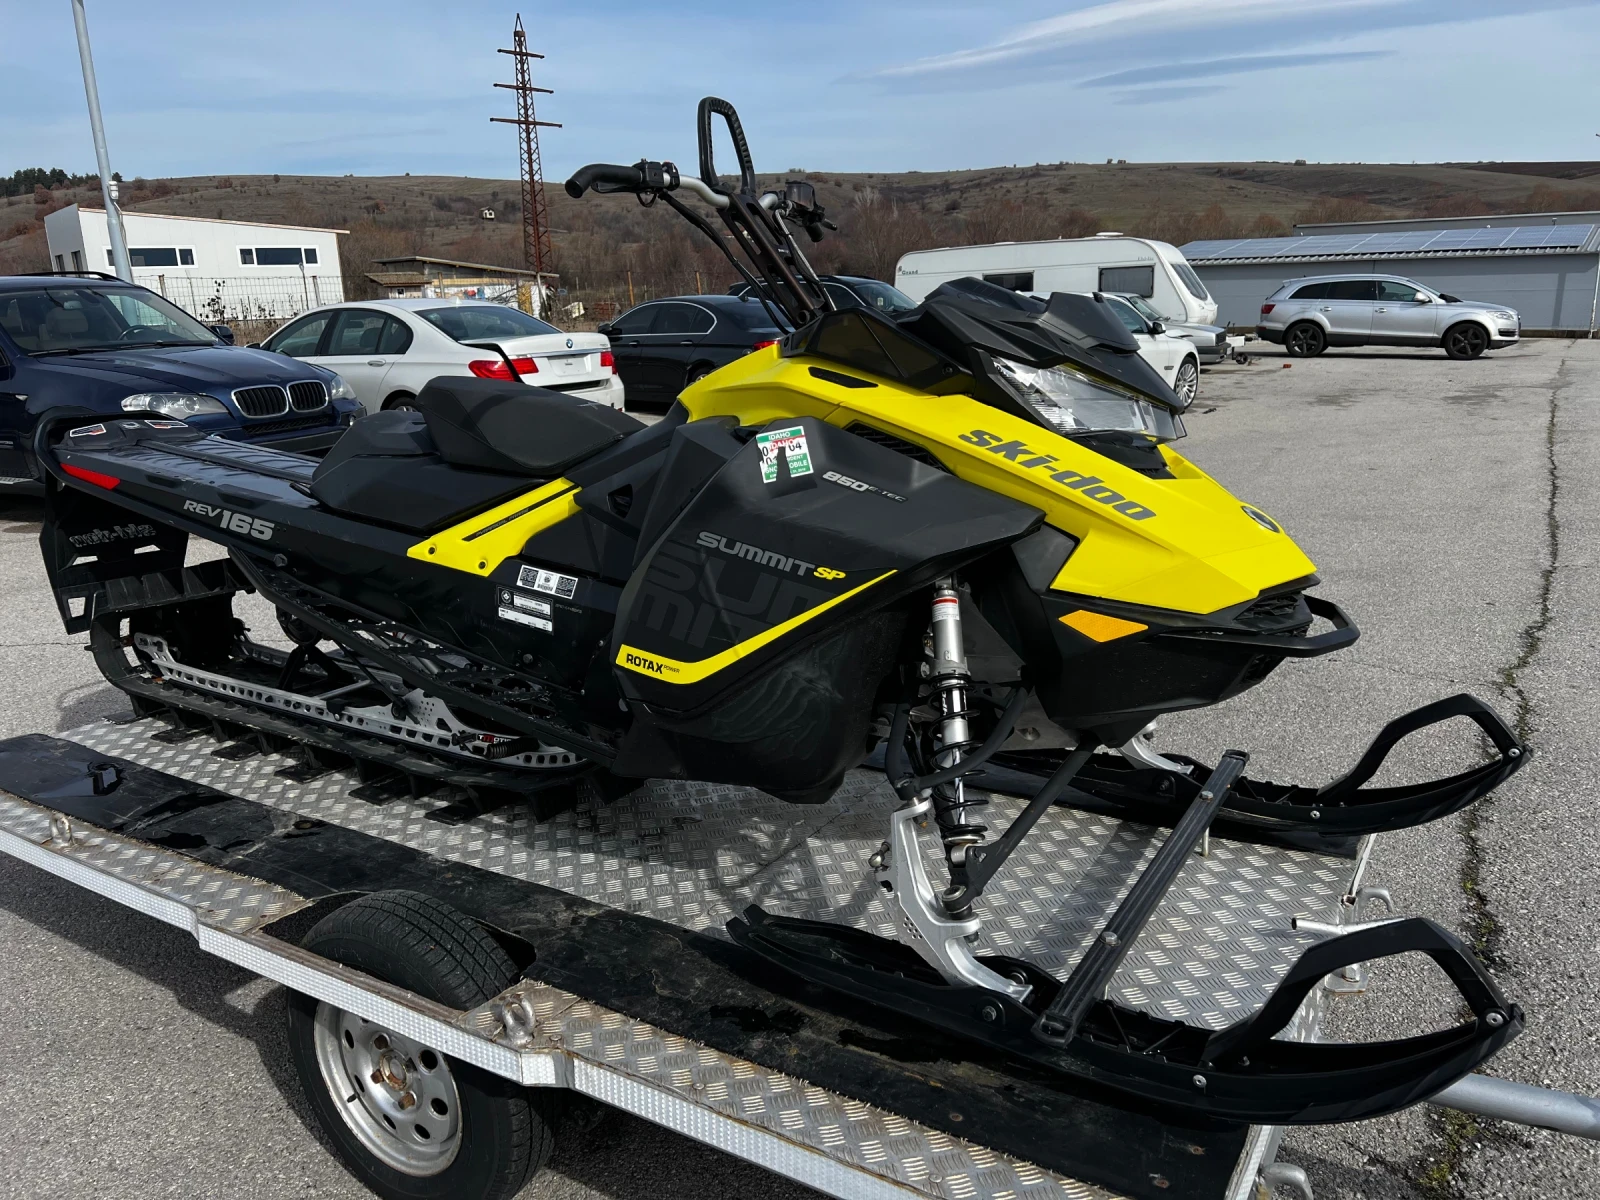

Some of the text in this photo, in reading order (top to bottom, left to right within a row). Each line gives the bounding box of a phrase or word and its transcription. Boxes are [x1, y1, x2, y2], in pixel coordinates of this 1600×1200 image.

[768, 431, 791, 441] IDAHO
[822, 470, 870, 492] 850
[957, 429, 1157, 521] ski-doo
[183, 499, 275, 540] REV 165
[696, 531, 846, 580] SUMMIT SP
[626, 652, 664, 675] ROTAX
